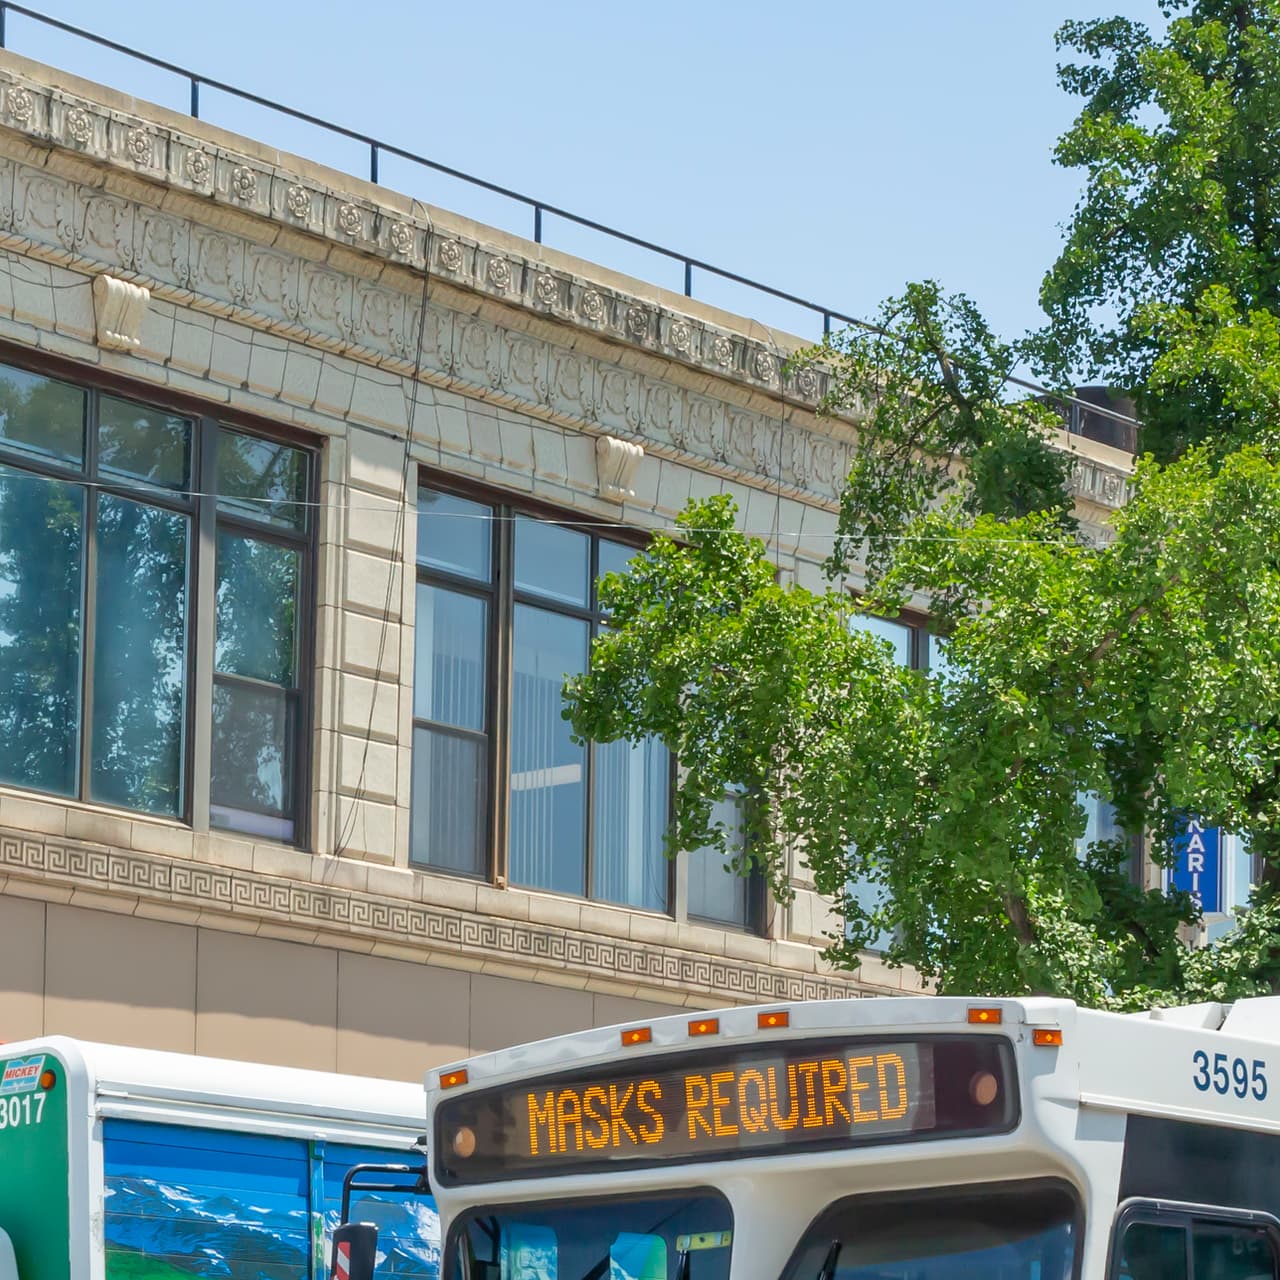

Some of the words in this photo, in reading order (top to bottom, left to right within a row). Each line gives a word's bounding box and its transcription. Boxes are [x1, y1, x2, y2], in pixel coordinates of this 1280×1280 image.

[4, 1064, 40, 1080] MICKEY
[1193, 1050, 1267, 1101] 3595
[526, 1080, 664, 1155] MASKS
[684, 1053, 908, 1139] REQUIRED
